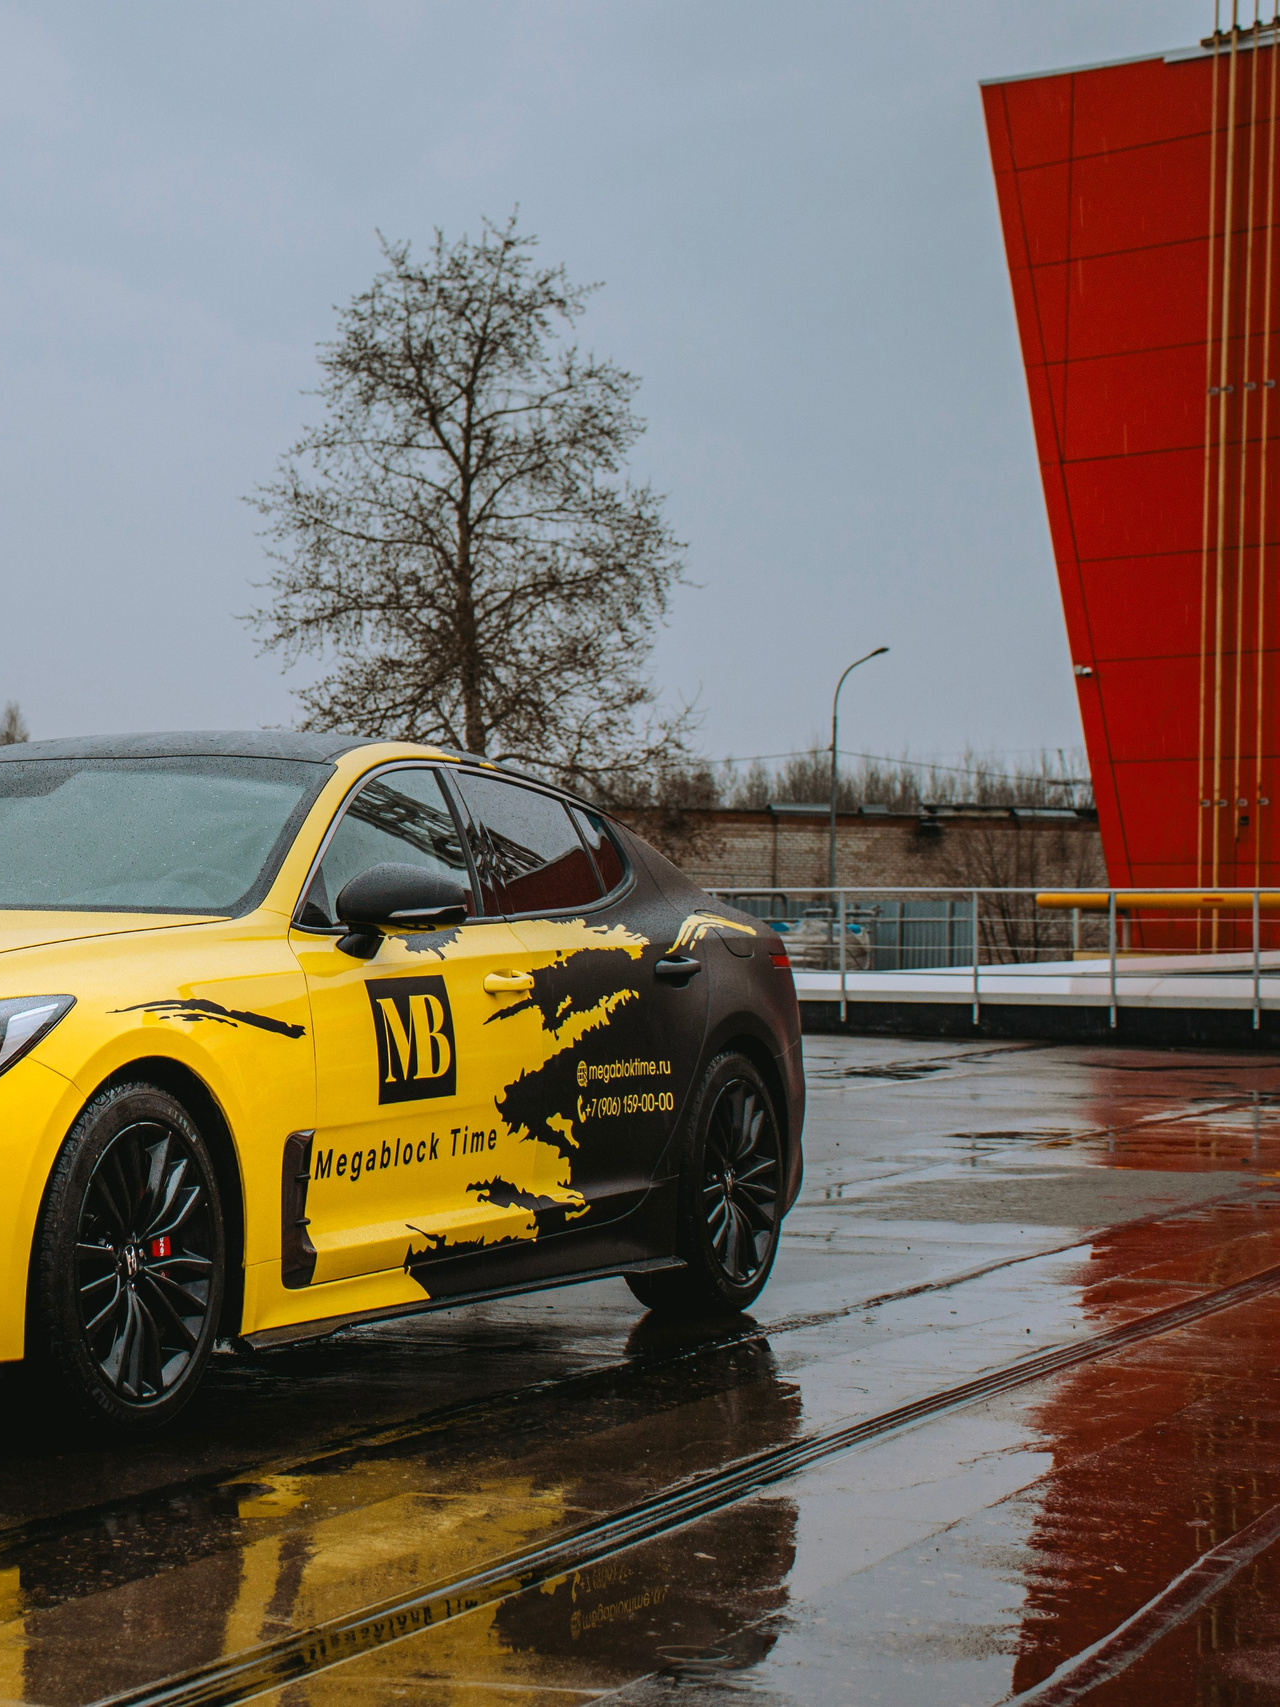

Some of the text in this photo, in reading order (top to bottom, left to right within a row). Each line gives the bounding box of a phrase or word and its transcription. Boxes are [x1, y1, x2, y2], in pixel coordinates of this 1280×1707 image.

[376, 994, 451, 1083] MB
[588, 1058, 671, 1083] megabloktime.ru
[585, 1092, 674, 1118] +7 (906) 159-00-00
[314, 1125, 497, 1182] Megablock Time
